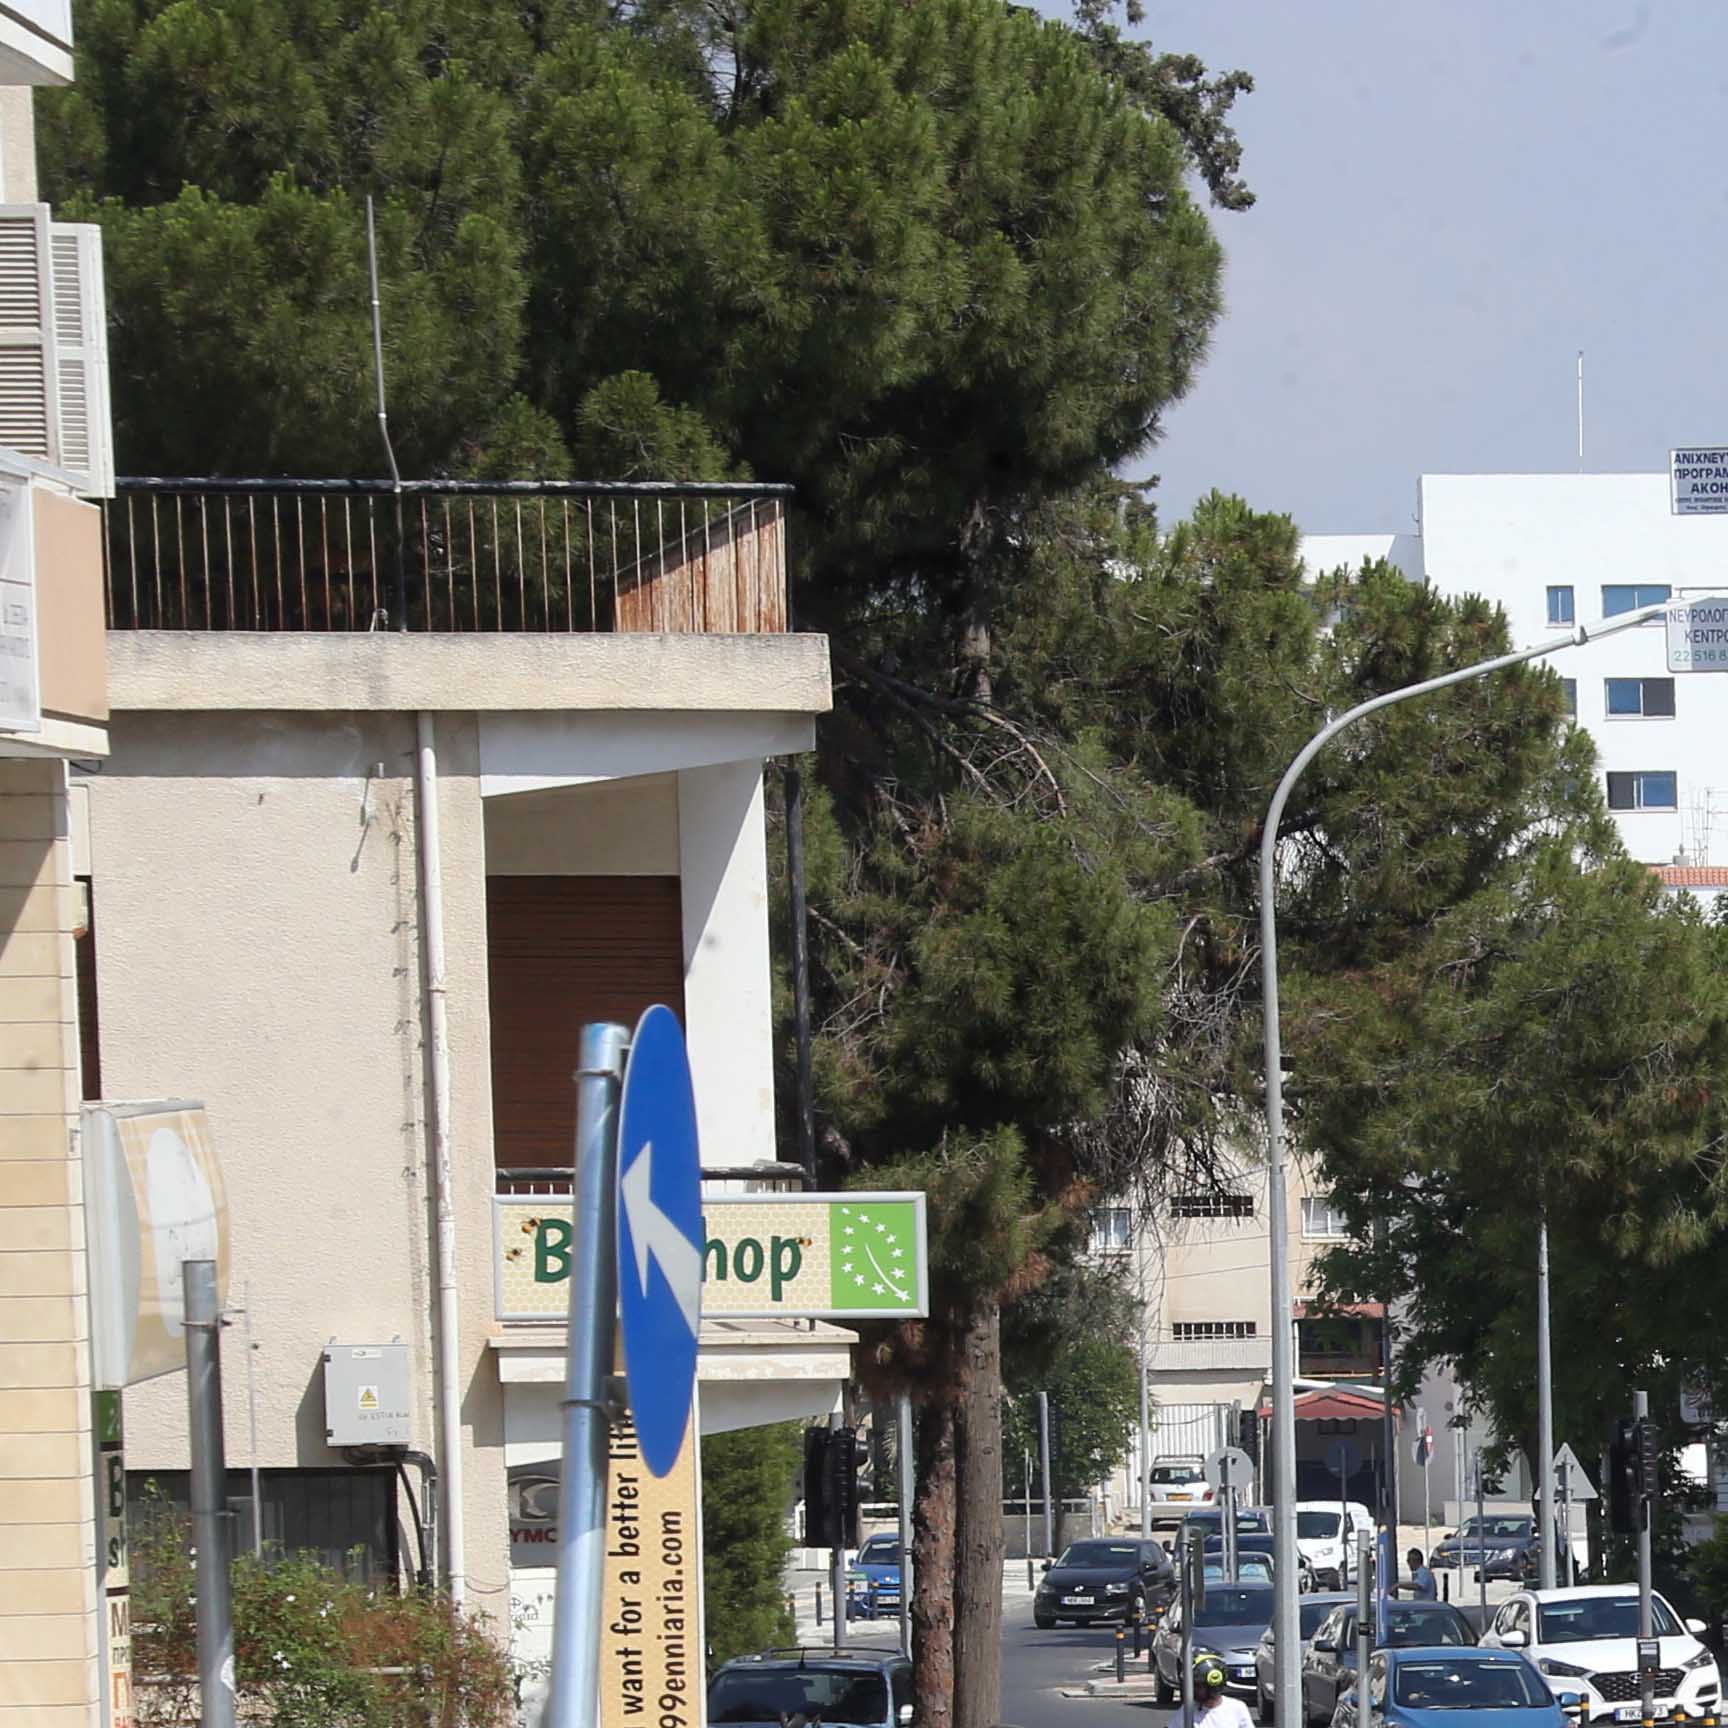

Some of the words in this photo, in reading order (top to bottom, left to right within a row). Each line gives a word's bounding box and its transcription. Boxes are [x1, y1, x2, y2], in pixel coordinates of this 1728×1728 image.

[700, 1215, 803, 1302] hop
[509, 1528, 558, 1544] YMC
[608, 1472, 640, 1557] better
[619, 1570, 641, 1585] a
[610, 1597, 643, 1636] for
[615, 1647, 645, 1715] want
